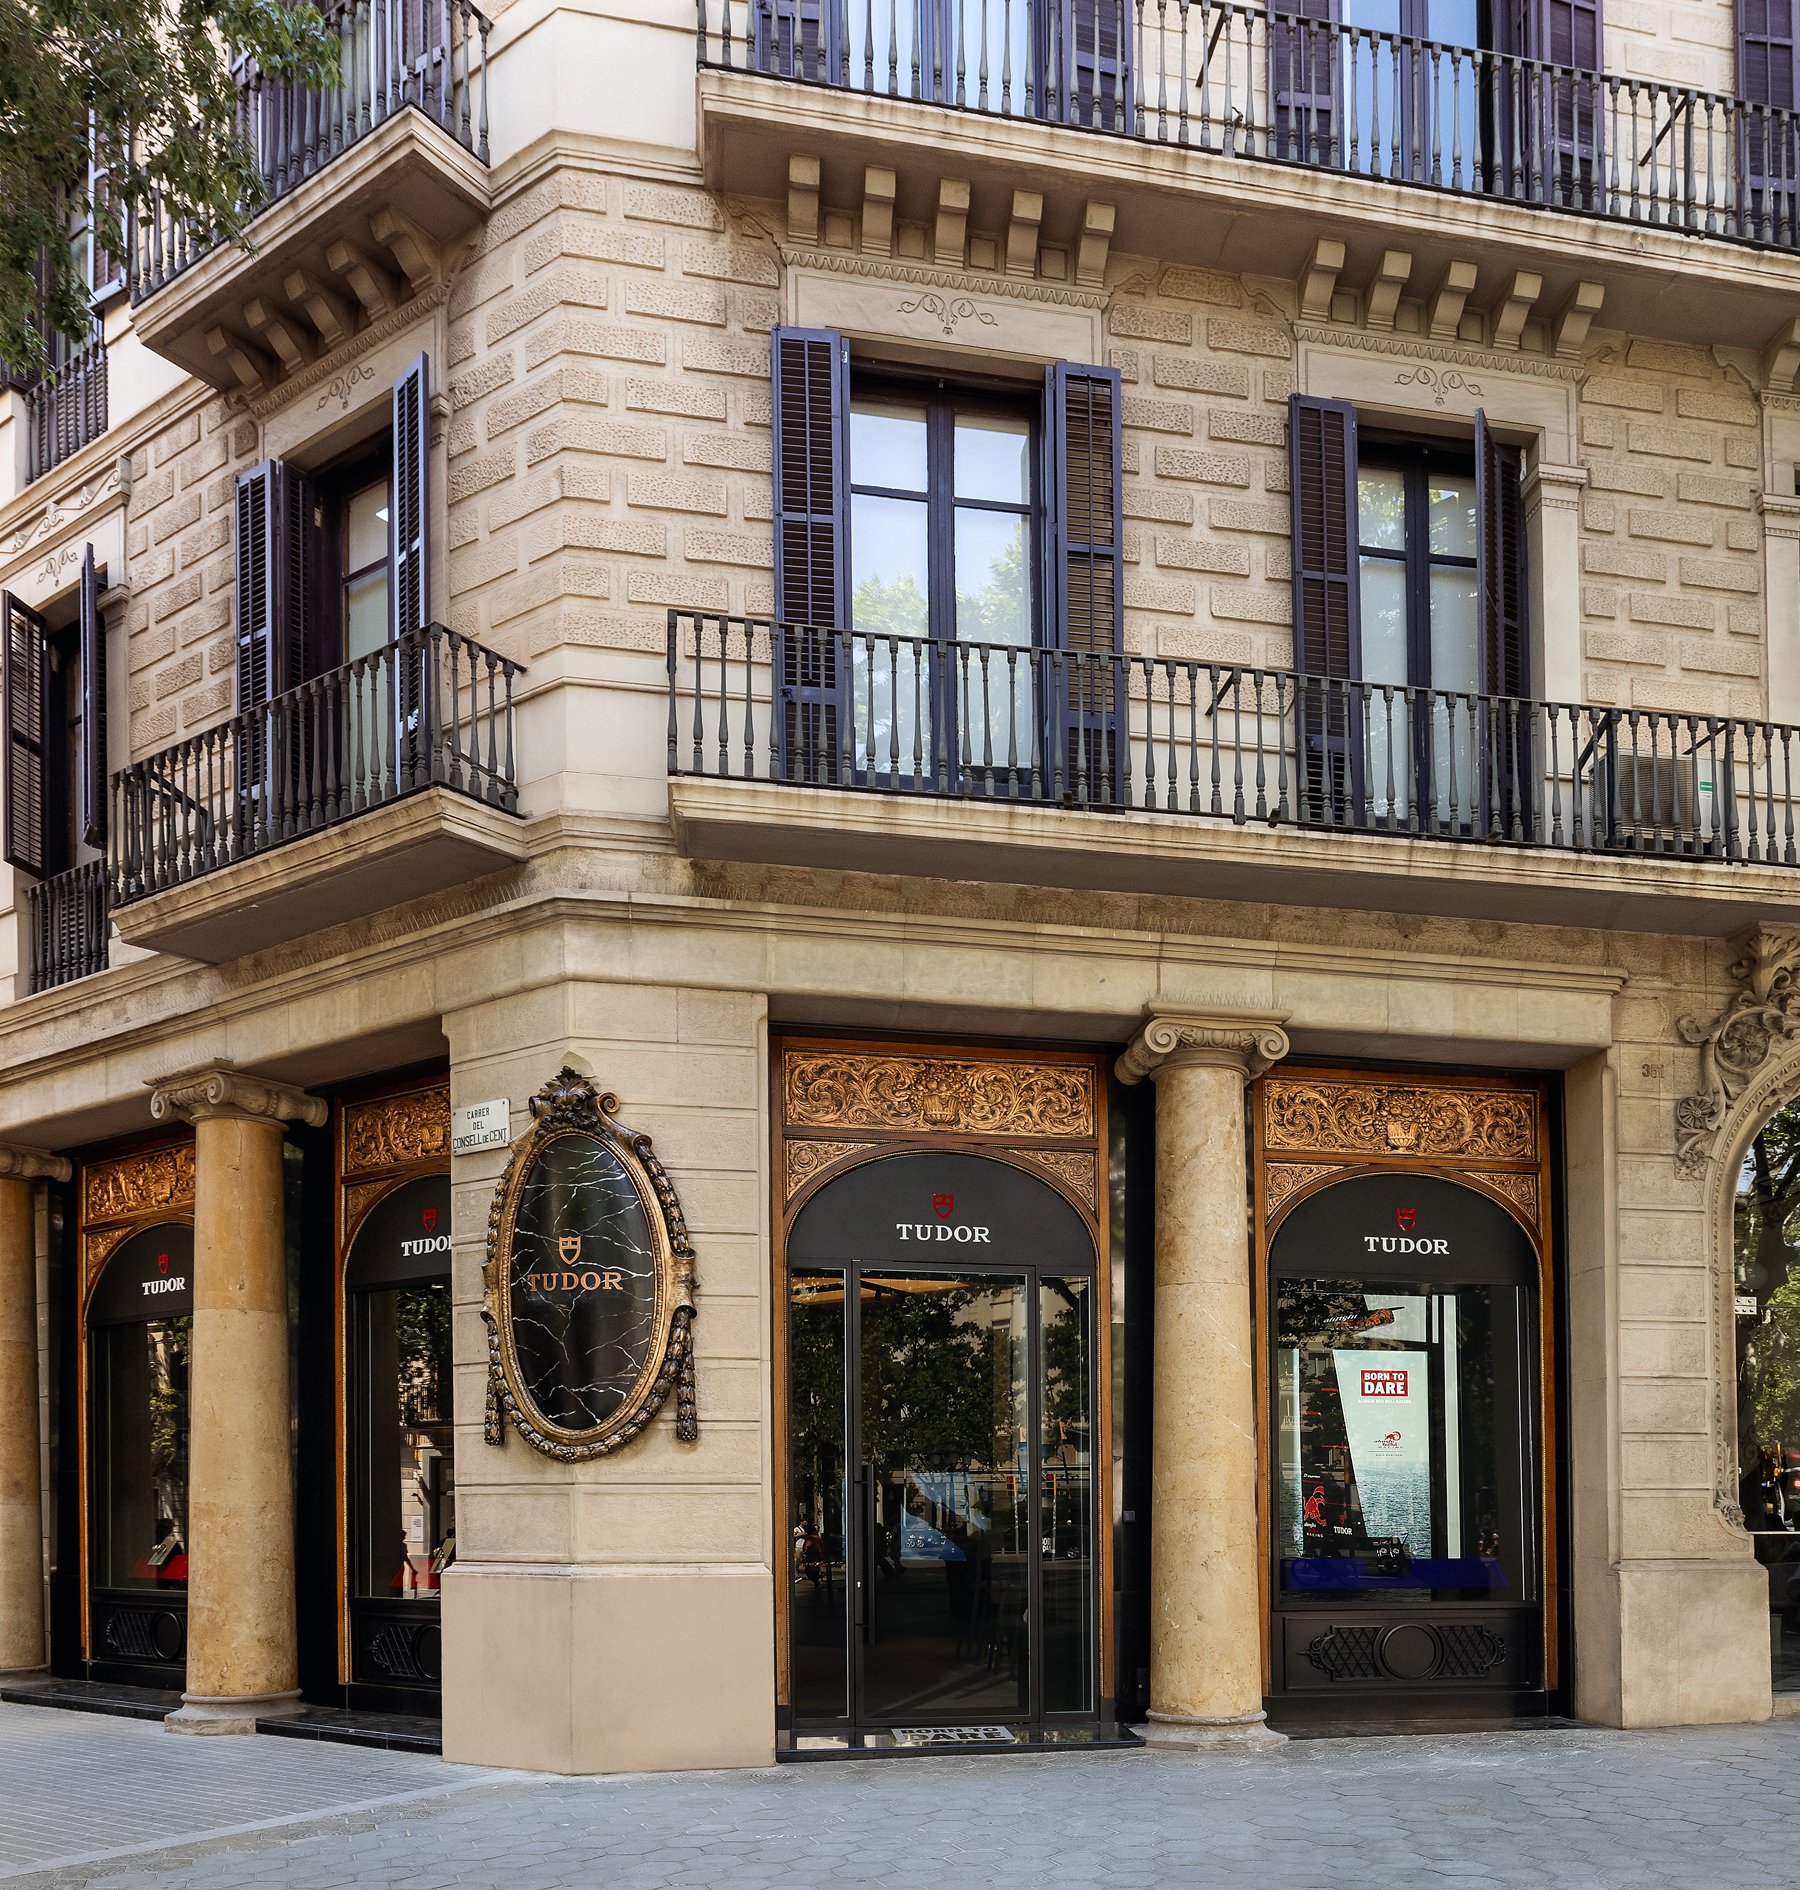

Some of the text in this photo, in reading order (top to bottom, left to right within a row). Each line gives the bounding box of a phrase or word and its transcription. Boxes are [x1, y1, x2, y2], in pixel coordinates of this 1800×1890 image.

[466, 1107, 490, 1120] CARRER
[472, 1120, 485, 1131] DEL
[452, 1127, 508, 1150] CONSELL DE CENT
[896, 1223, 991, 1243] TUDOR
[1364, 1236, 1450, 1255] TUDOR
[142, 1277, 186, 1296] TUDOR
[527, 1271, 624, 1292] TUDOR
[1364, 1372, 1405, 1381] BORN TO
[1364, 1381, 1405, 1394] DARE
[1333, 1525, 1353, 1536] TUDOR
